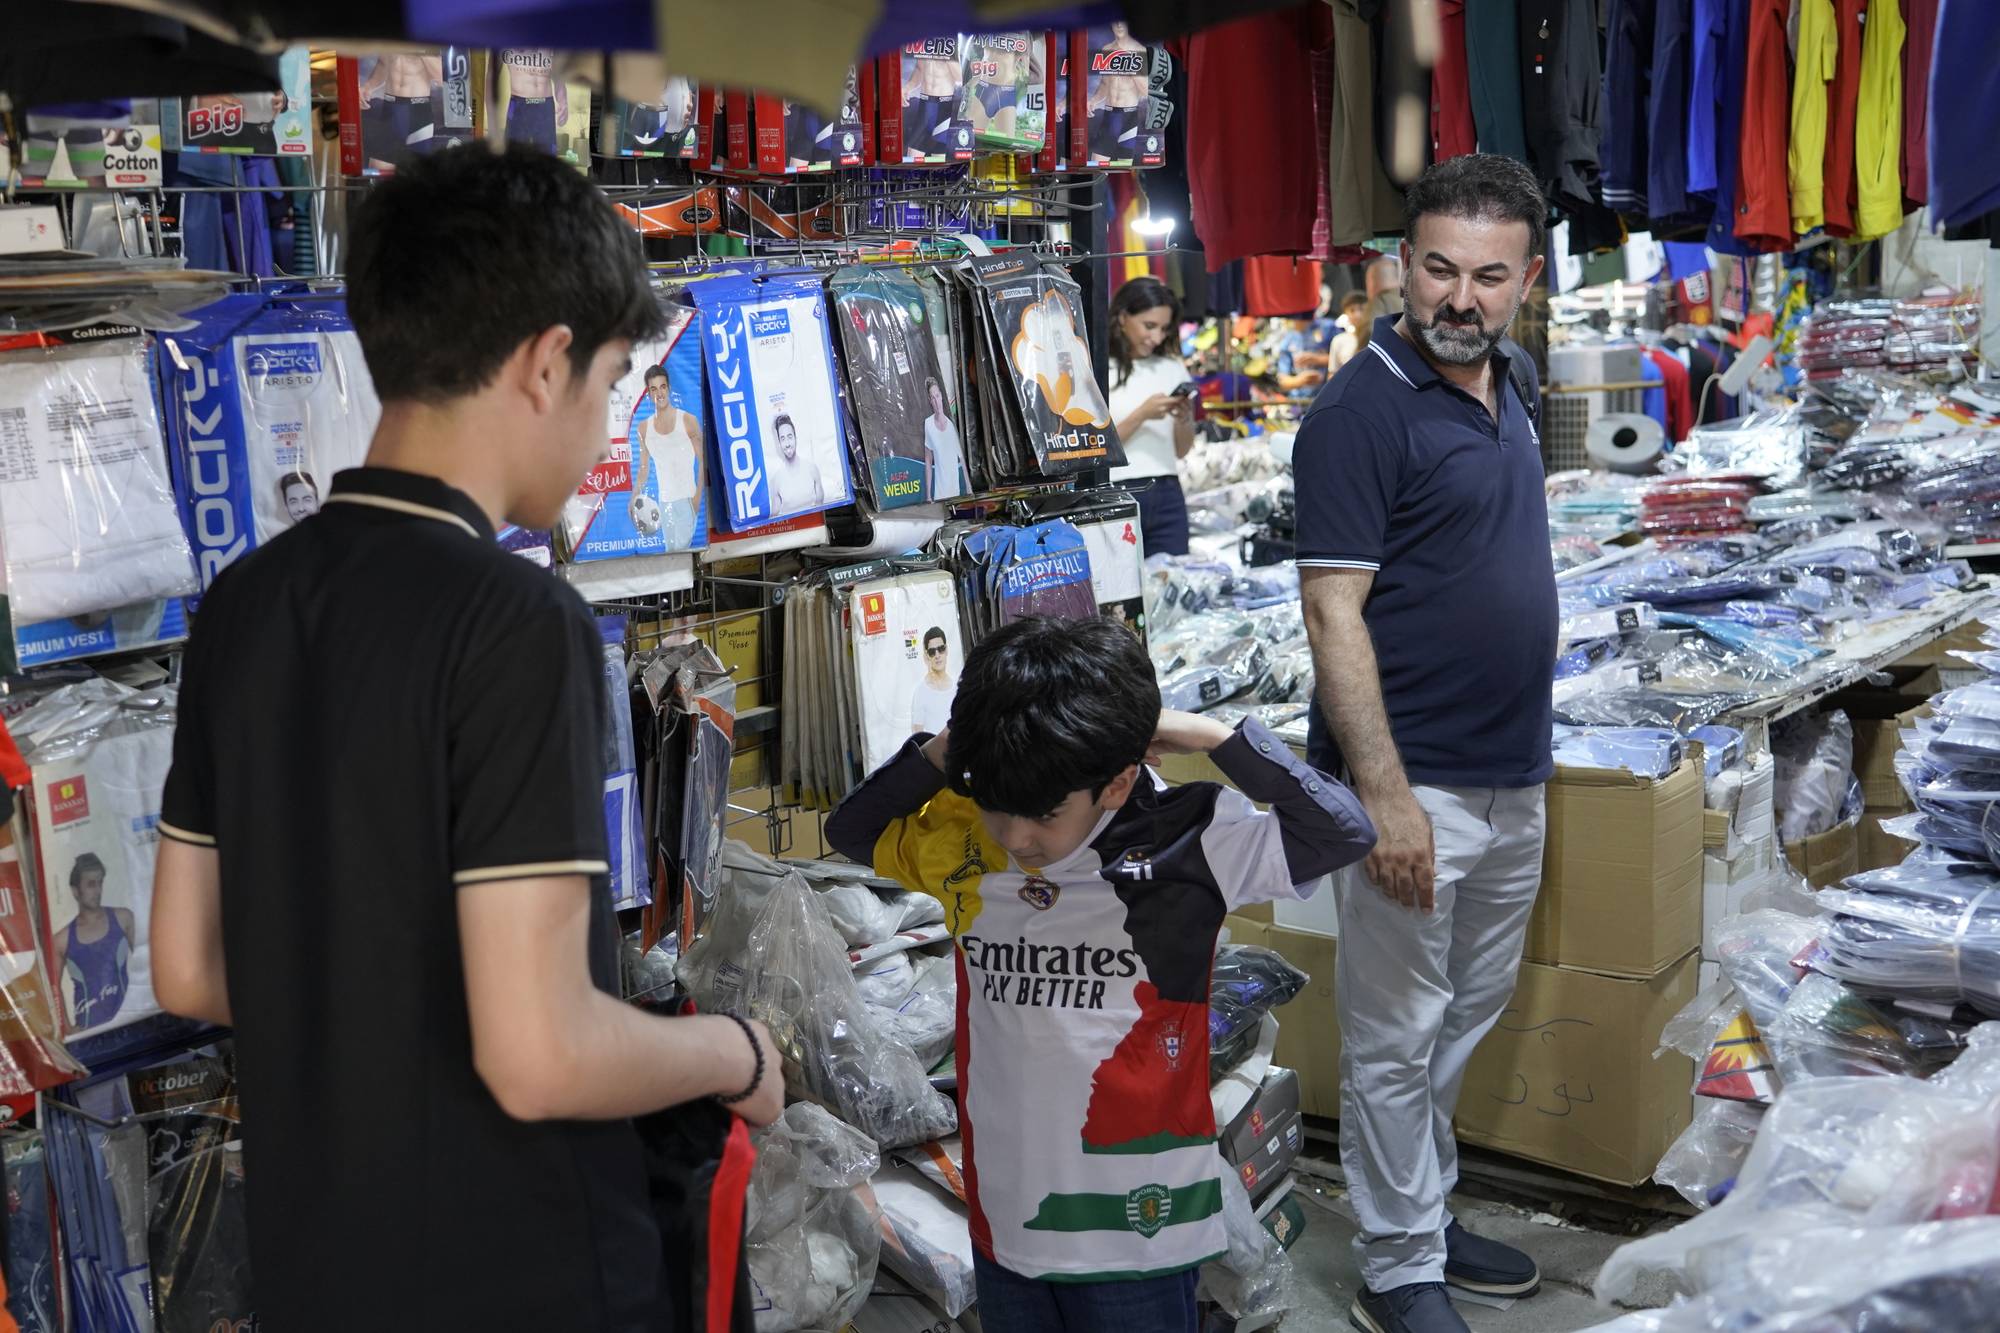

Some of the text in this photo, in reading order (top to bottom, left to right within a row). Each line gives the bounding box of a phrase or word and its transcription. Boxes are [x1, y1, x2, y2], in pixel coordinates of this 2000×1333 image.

[905, 37, 955, 56] Mens
[991, 36, 1026, 52] HERO
[502, 49, 550, 68] Gentle
[1092, 50, 1142, 71] Men's
[971, 61, 997, 77] Big
[187, 103, 243, 139] Big
[103, 154, 158, 170] Cotton
[979, 261, 1006, 273] Hind
[71, 326, 137, 339] Collection
[754, 319, 787, 335] ROCKY
[760, 336, 786, 346] ARISTO
[264, 376, 313, 386] ARISTO
[1044, 429, 1080, 449] Hind
[593, 467, 627, 491] Club
[883, 481, 919, 498] WENUS
[586, 538, 635, 553] PREMIUM
[834, 568, 854, 580] CITY
[67, 630, 105, 648] VEST
[719, 628, 757, 639] Premium
[729, 639, 750, 649] Vest
[962, 935, 1138, 978] Emirates
[1015, 976, 1106, 1010] BETTER
[184, 1134, 223, 1149] COON
[1131, 1186, 1166, 1202] SPORTING
